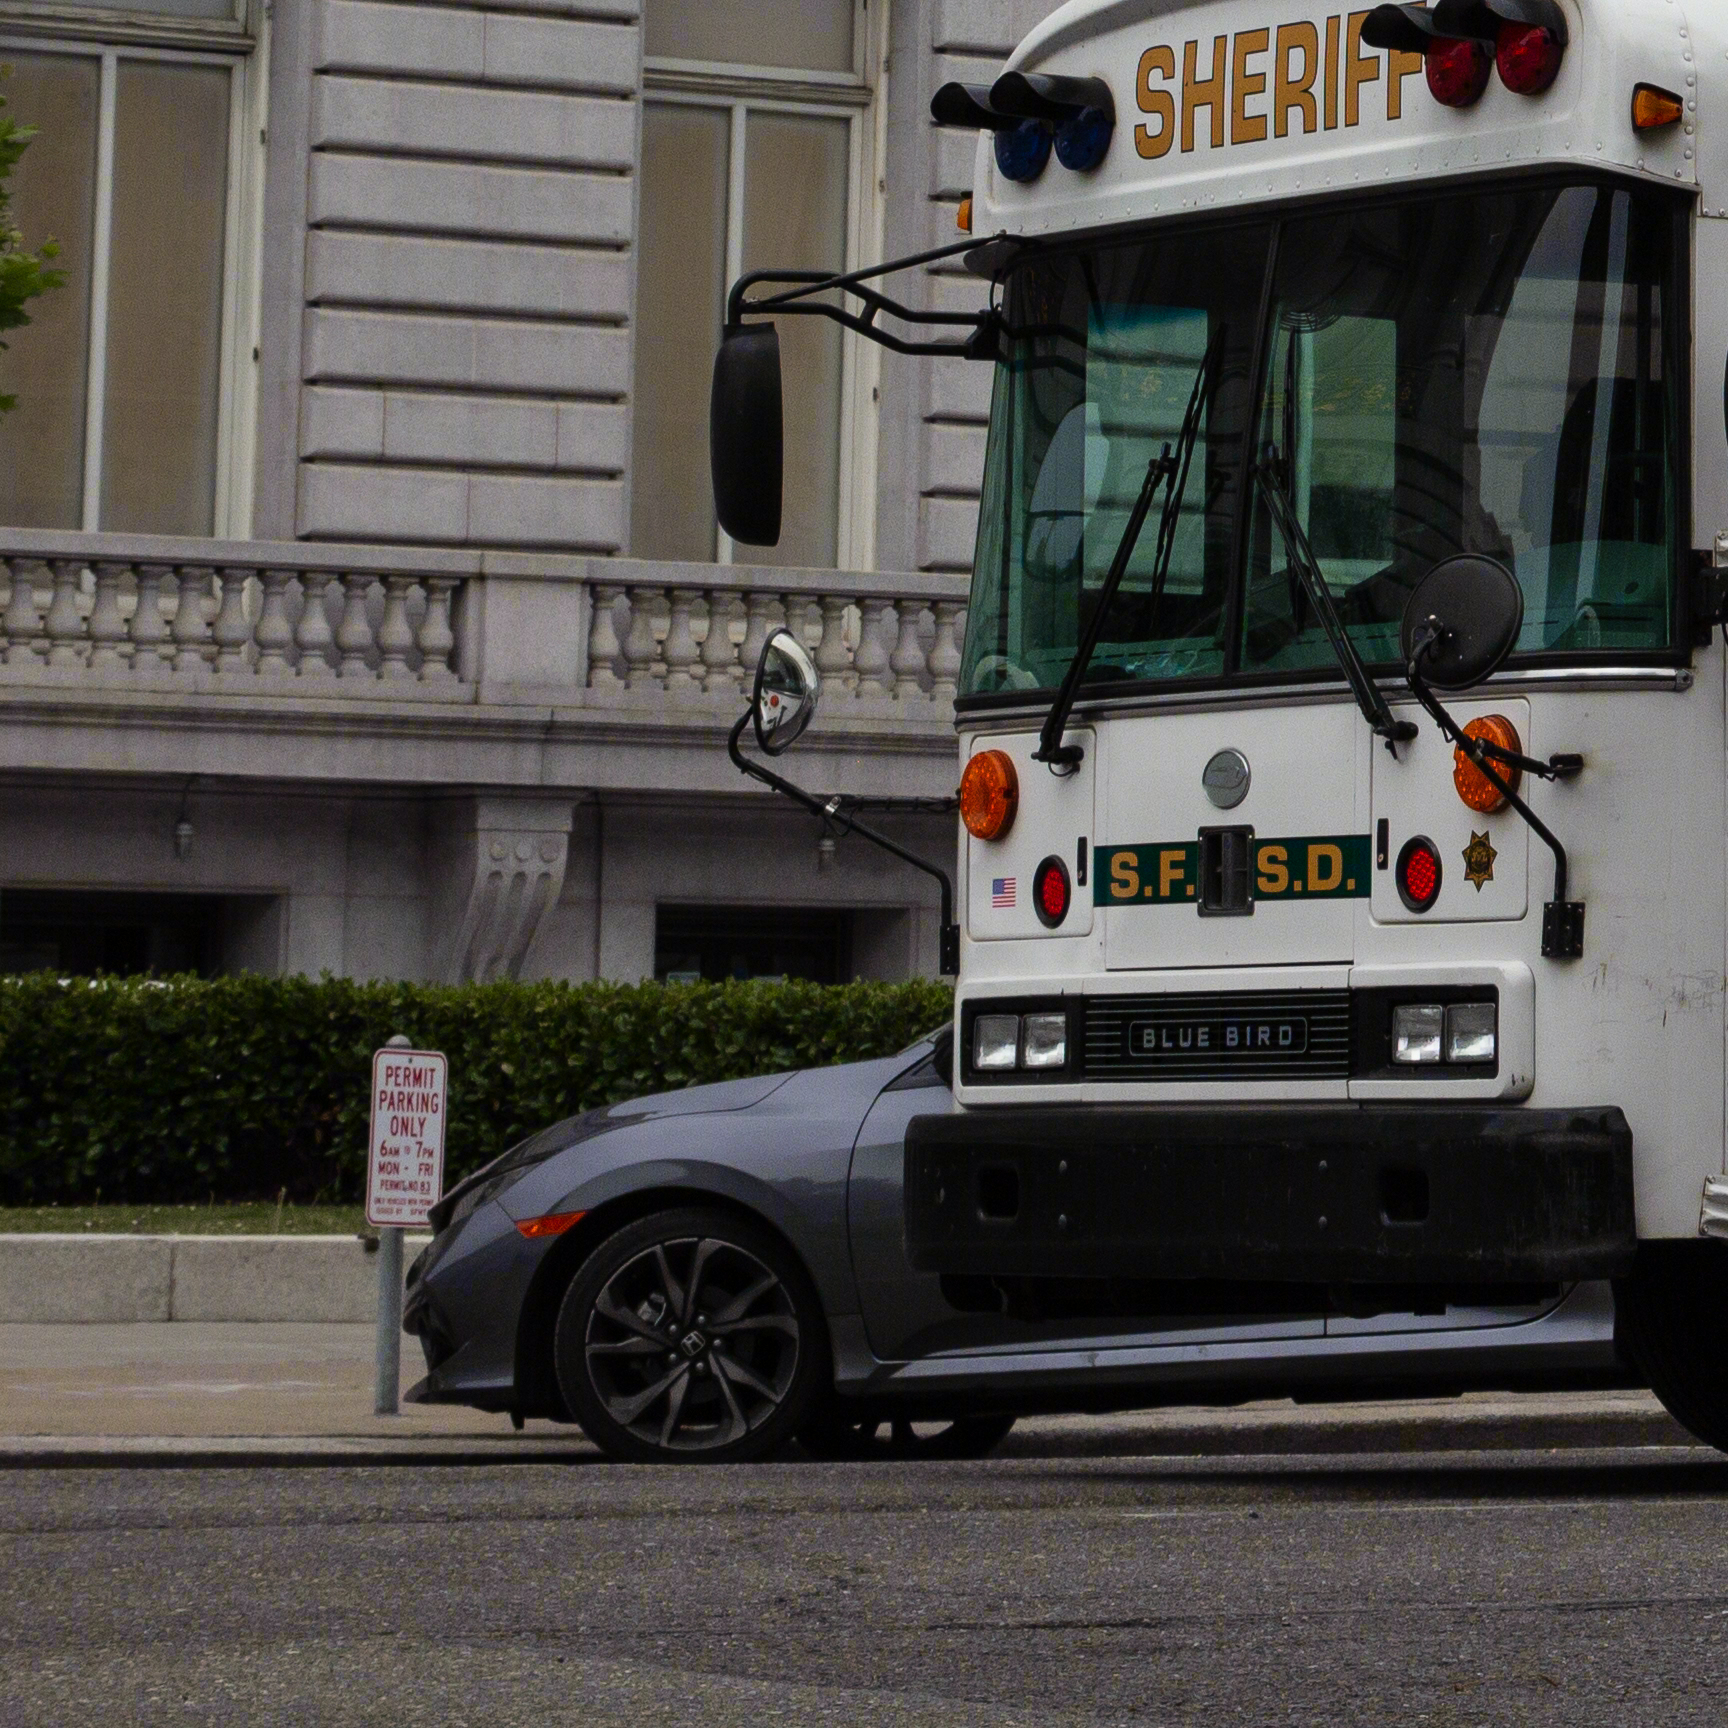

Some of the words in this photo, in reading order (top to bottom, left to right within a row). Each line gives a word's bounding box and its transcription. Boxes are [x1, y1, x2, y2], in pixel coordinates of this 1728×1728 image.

[1134, 0, 1427, 160] SHERIFF
[1143, 1027, 1210, 1048] BLUE
[1226, 1025, 1292, 1047] BIRD
[385, 1065, 437, 1089] PERMIT
[379, 1089, 439, 1114] PARKING
[390, 1115, 427, 1138] ONLY
[378, 1161, 400, 1176] MON
[418, 1162, 434, 1177] FRI
